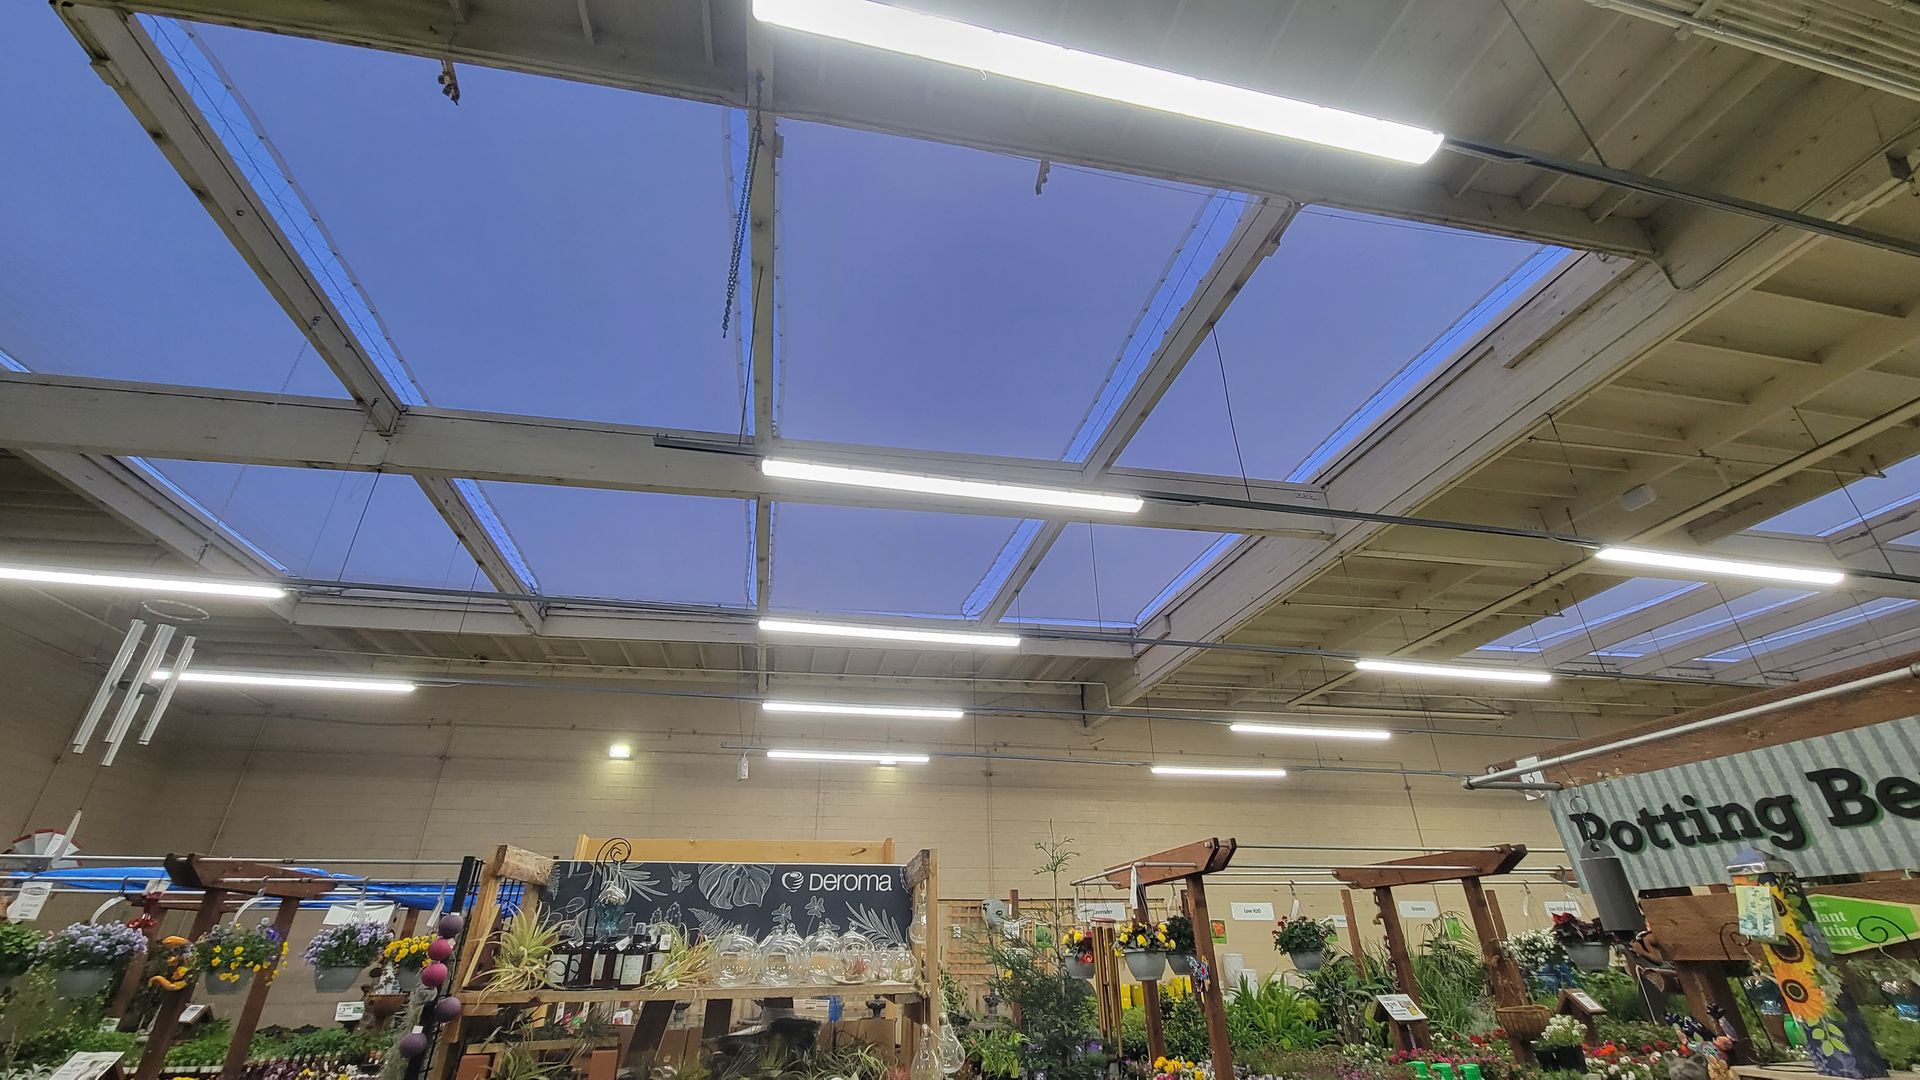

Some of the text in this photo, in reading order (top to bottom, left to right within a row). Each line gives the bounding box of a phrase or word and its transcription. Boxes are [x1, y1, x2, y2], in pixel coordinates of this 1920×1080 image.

[1569, 767, 1920, 853] Potting Be
[1813, 910, 1847, 923] lant
[1823, 924, 1863, 940] tting
